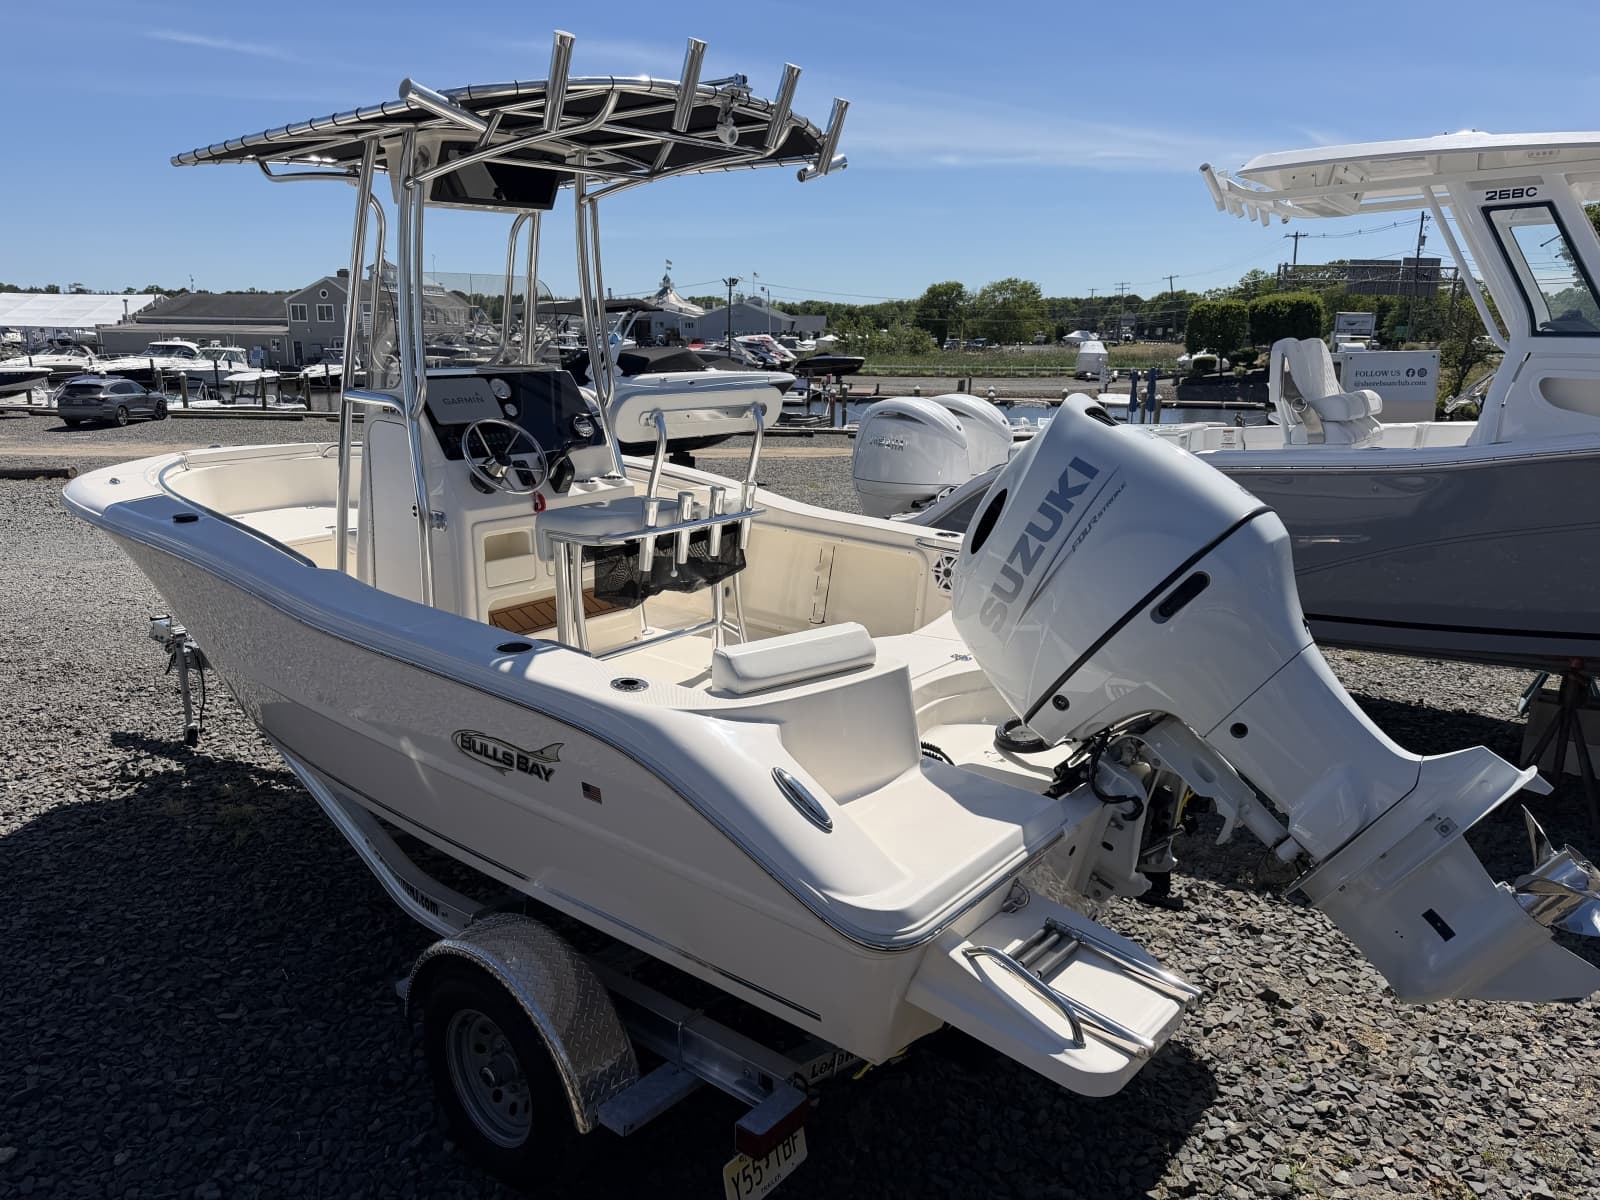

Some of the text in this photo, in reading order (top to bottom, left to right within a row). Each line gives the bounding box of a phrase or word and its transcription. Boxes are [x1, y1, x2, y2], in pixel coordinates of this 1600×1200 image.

[1355, 369, 1401, 378] FOLLOW US
[442, 396, 485, 406] GARMIN
[979, 456, 1100, 634] SUZUKI
[460, 733, 555, 782] BULLS BAY
